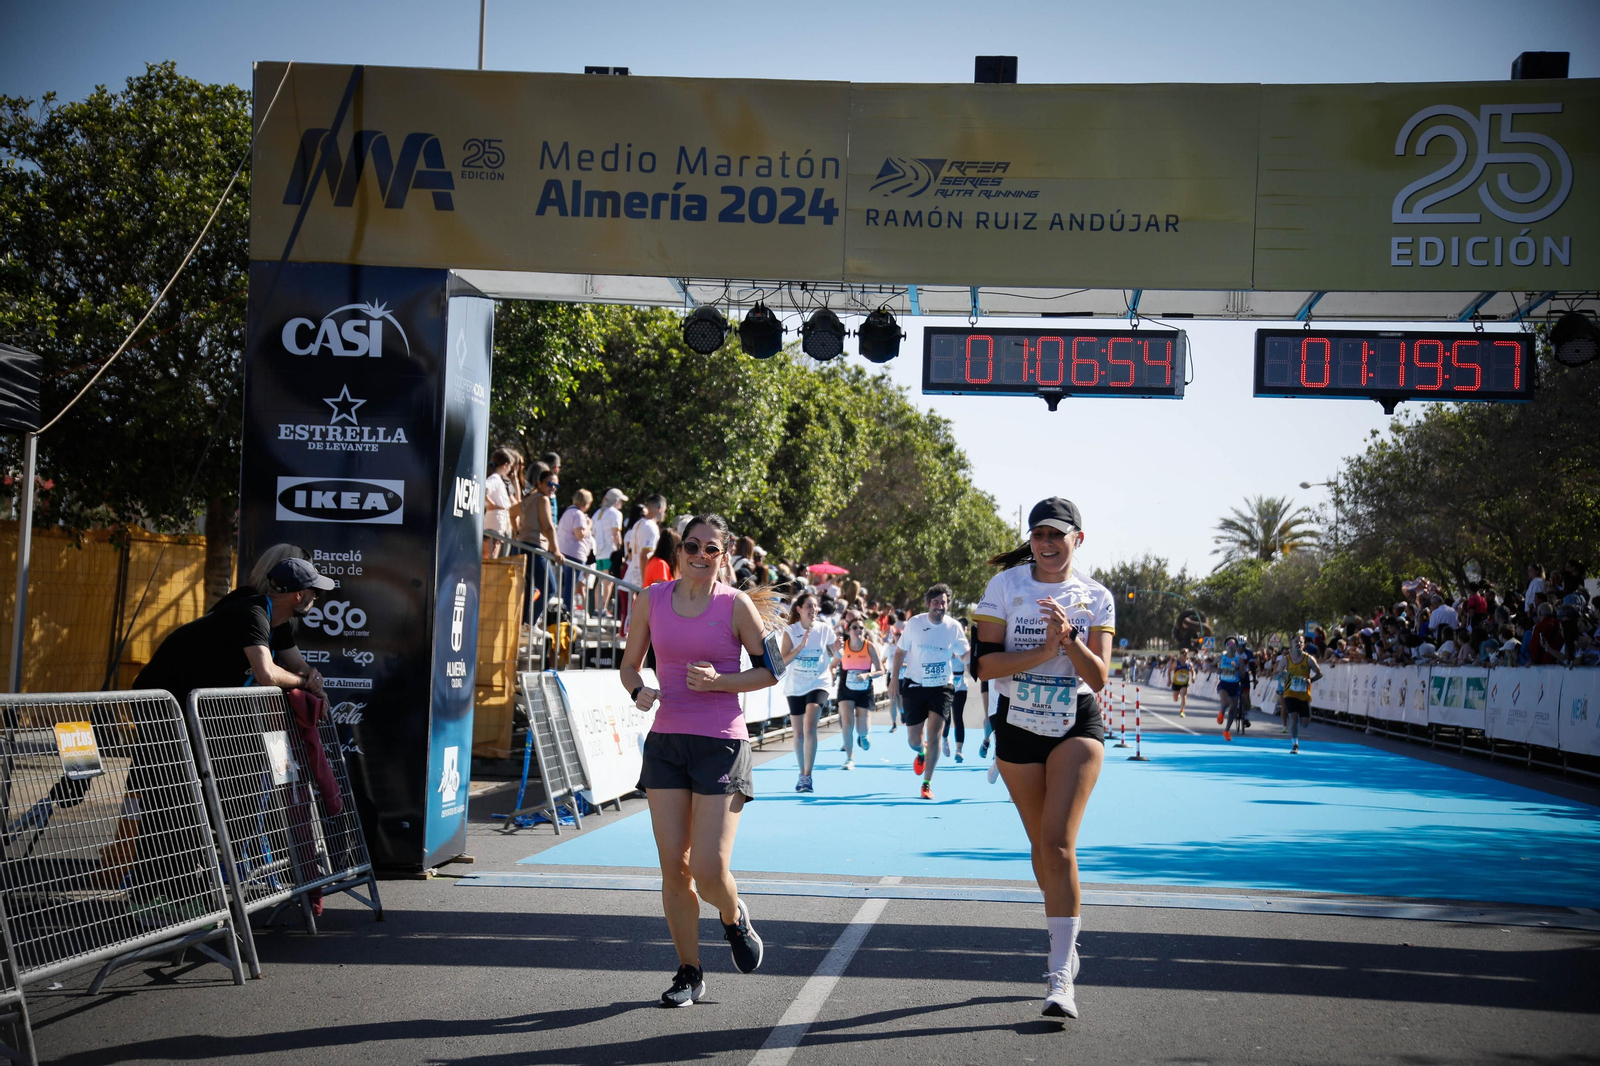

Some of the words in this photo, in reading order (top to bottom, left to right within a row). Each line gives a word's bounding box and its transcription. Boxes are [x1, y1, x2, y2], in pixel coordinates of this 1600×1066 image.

[461, 138, 506, 170] 25
[539, 140, 657, 174] Medio
[675, 145, 840, 180] Maratón
[946, 160, 1011, 176] RFEA
[1391, 103, 1574, 224] 25
[460, 170, 505, 181] EDICIÓN
[940, 176, 1004, 188] SERIES
[535, 178, 709, 221] Almería
[717, 184, 840, 226] 2024
[933, 188, 975, 198] RUTA
[977, 190, 1041, 200] RUNNING
[865, 206, 963, 229] RAMÓN
[976, 211, 1038, 231] RUIZ
[1049, 209, 1180, 233] ANDÚJAR
[1390, 228, 1571, 267] EDICIÓN
[281, 316, 383, 358] CASI
[277, 423, 409, 444] ESTRELLA
[307, 441, 324, 450] DE
[325, 442, 379, 452] LEVANTE
[294, 489, 390, 511] IKEA
[313, 549, 362, 562] Barceló
[313, 563, 344, 575] Cabo
[347, 563, 363, 575] de
[302, 599, 367, 636] ego
[1014, 616, 1044, 626] Medio
[1013, 624, 1047, 635] Almer
[353, 651, 375, 667] 40
[924, 665, 945, 675] 5485
[323, 679, 335, 687] de
[1016, 682, 1072, 706] 5174
[1031, 702, 1052, 710] MARTA
[60, 730, 93, 752] portos
